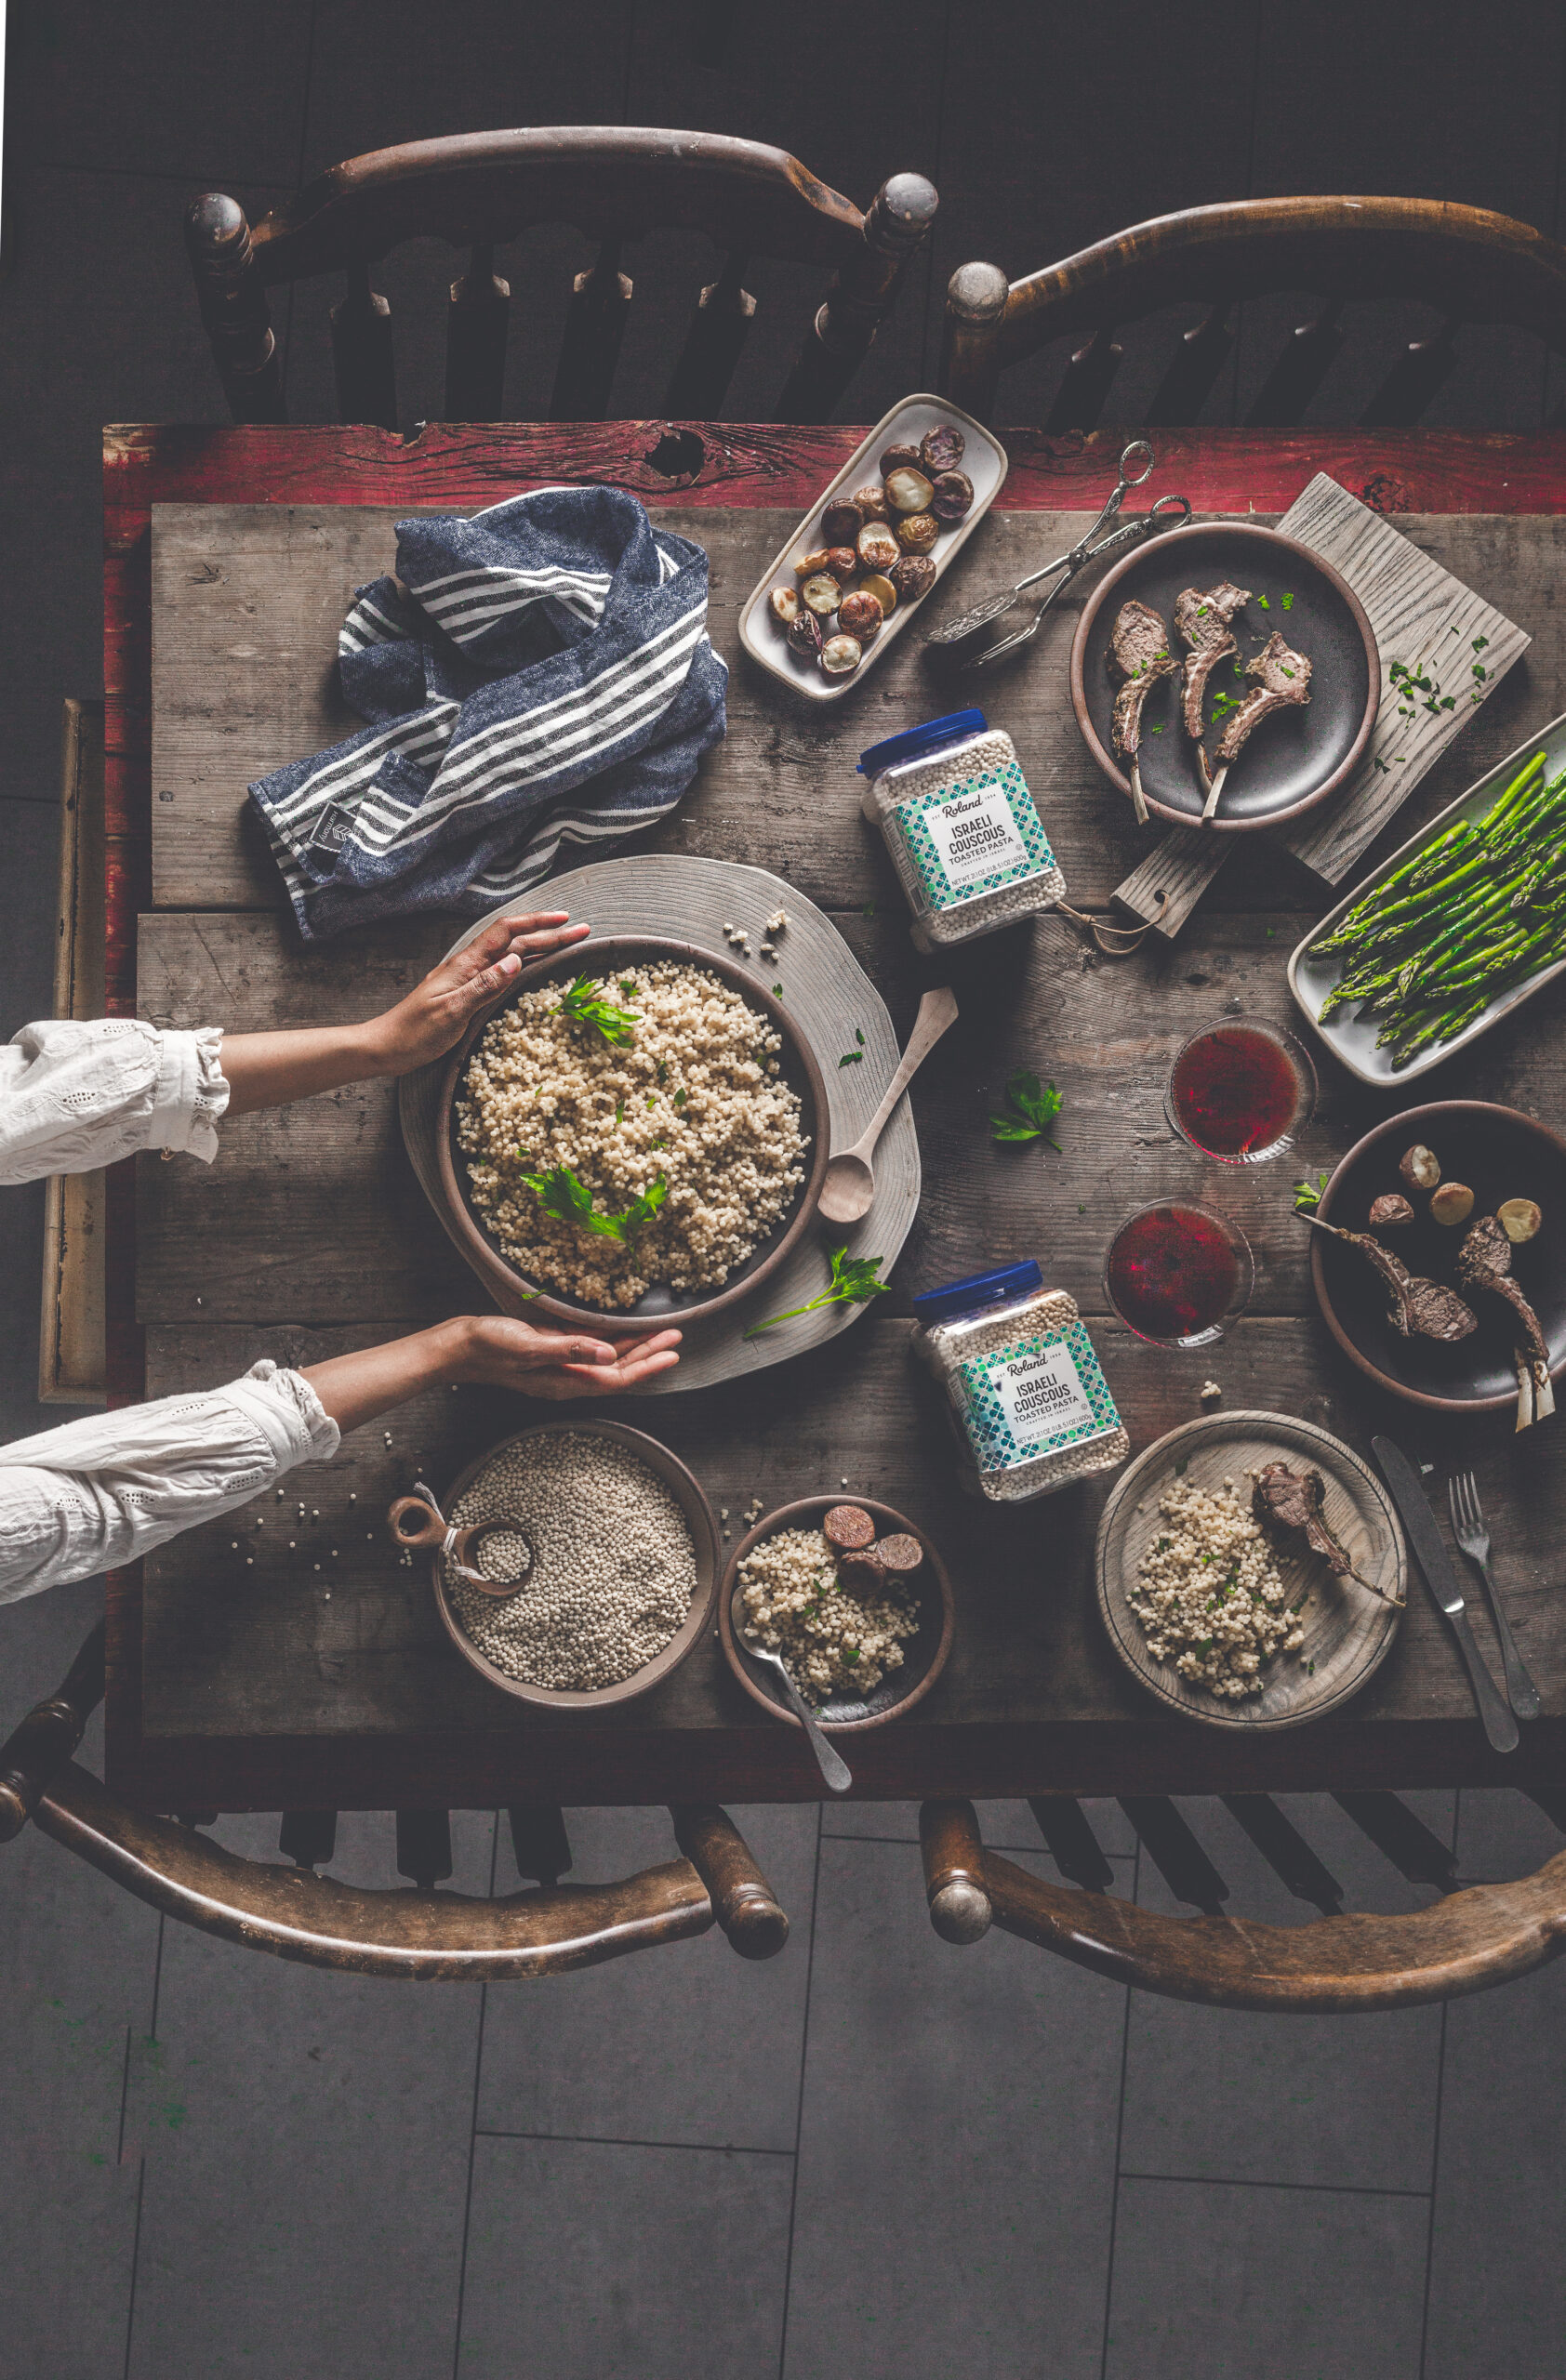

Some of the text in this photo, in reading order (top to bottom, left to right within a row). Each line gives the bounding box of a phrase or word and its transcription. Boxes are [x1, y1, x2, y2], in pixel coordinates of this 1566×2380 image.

[942, 794, 983, 818] Roland
[951, 814, 992, 839] ISRAELI
[949, 825, 1005, 854] COUSCOUS
[949, 837, 1014, 865] TOASTED PASTA
[1014, 855, 1027, 864] 600g
[1007, 1353, 1048, 1376] Roland
[1016, 1373, 1057, 1397] ISRAELI
[1014, 1384, 1070, 1413] COUSCOUS
[1014, 1395, 1079, 1423] TOASTED PASTA
